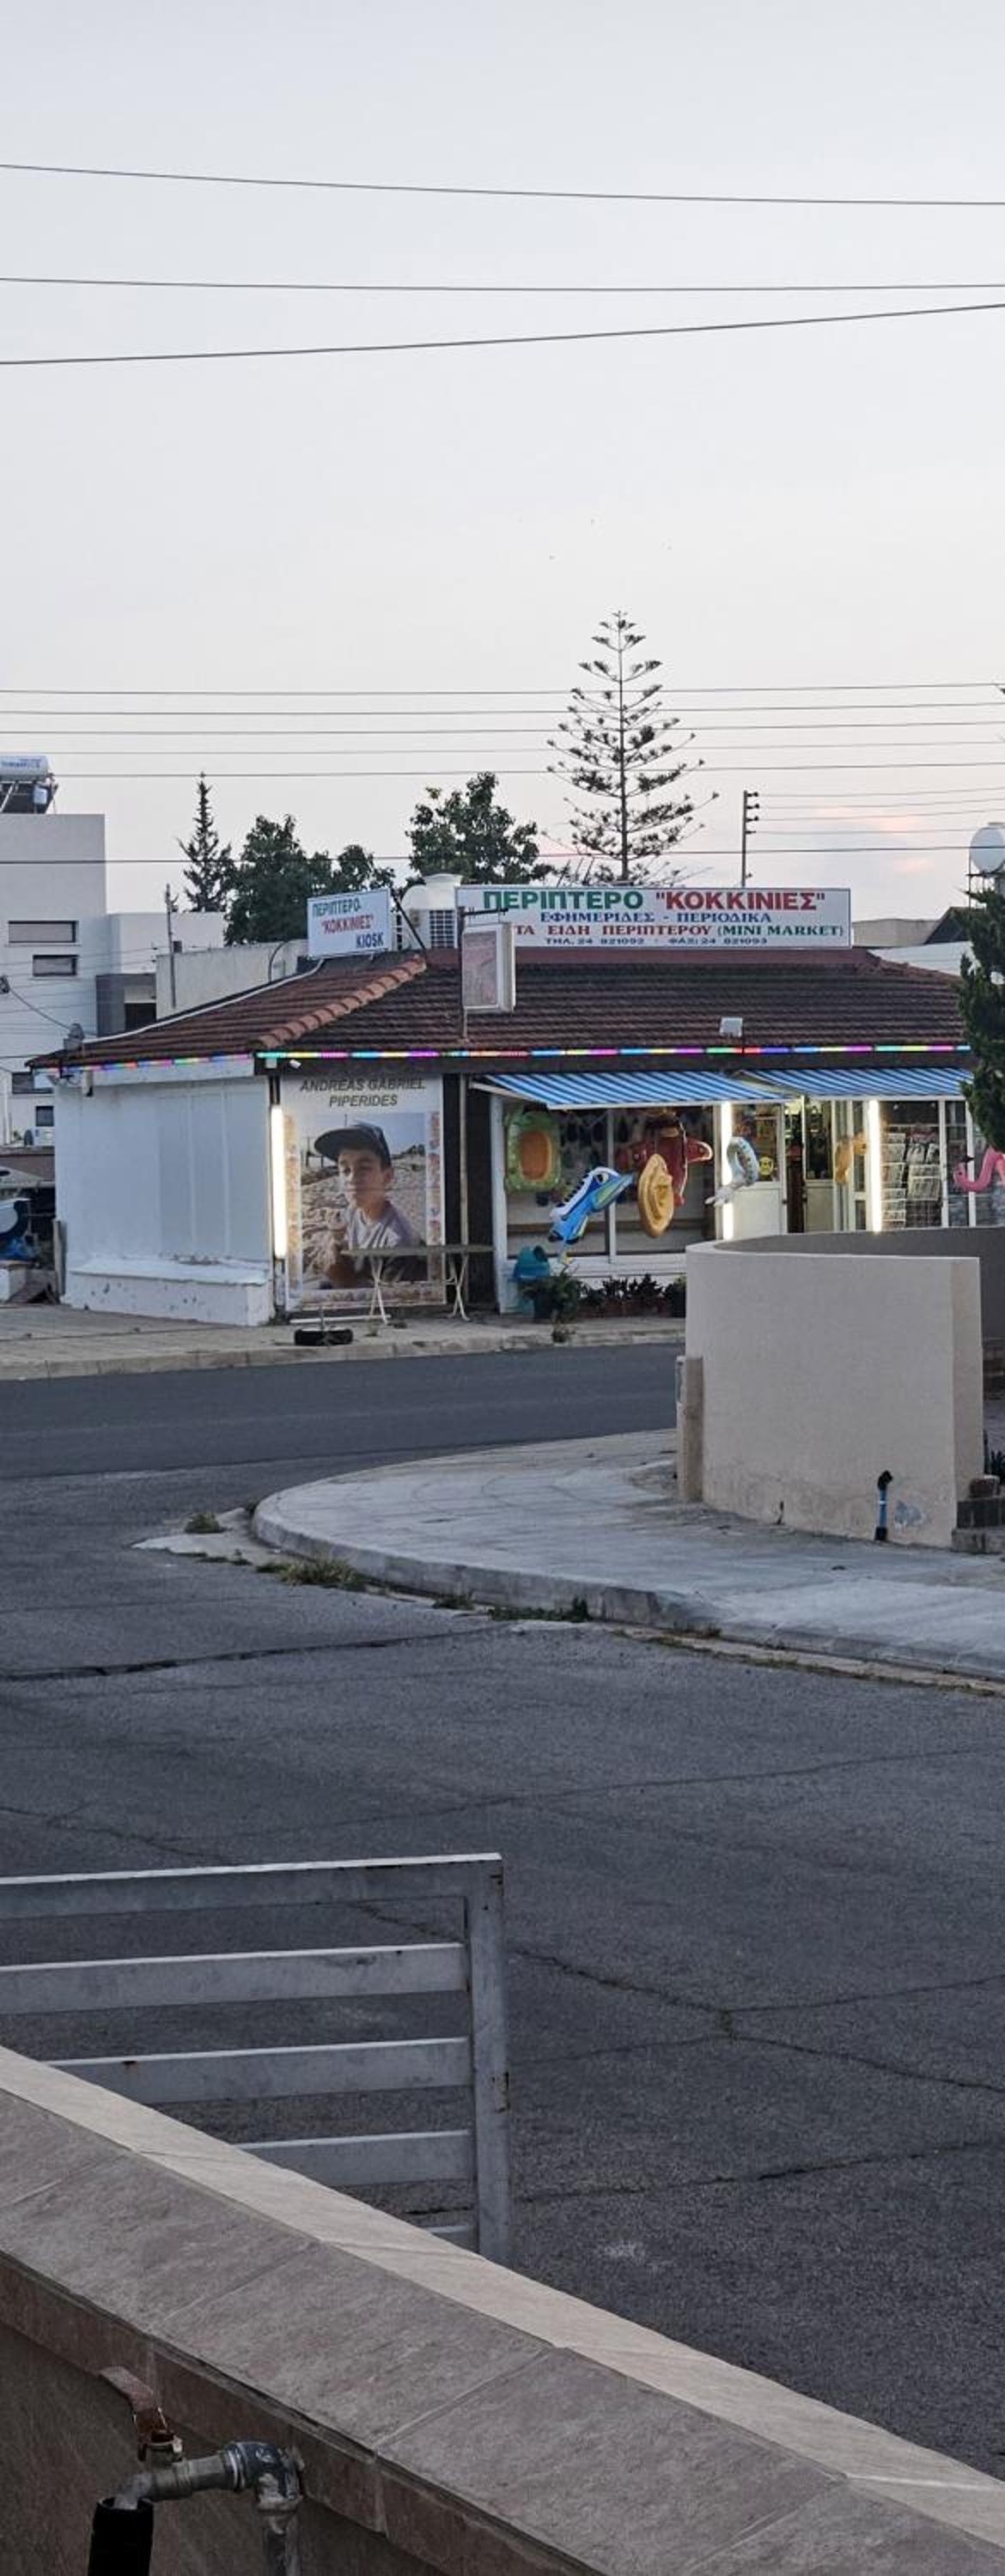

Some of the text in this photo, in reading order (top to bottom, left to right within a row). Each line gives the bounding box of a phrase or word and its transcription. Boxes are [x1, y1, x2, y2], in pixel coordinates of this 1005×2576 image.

[484, 890, 825, 910] ΠΕΡΙΠΤΕΡΟ "ΚΟΚΚΙΝΙΕΣ"
[540, 912, 655, 923] ΕΦΗΜΕΡΙΔΕΣ
[677, 913, 771, 923] ΠΕΡΙΟΔΙΚΑ
[547, 925, 590, 935] ΕΙΔΗ
[602, 925, 711, 936] ΠΕΡΙΠΤΕΡΟΥ
[717, 925, 761, 937] (MINI
[767, 925, 844, 937] MARKET)
[356, 933, 384, 948] KIOSK
[300, 1078, 427, 1092] ANDREAS GABRIEL
[329, 1094, 399, 1108] PIPERIDES
